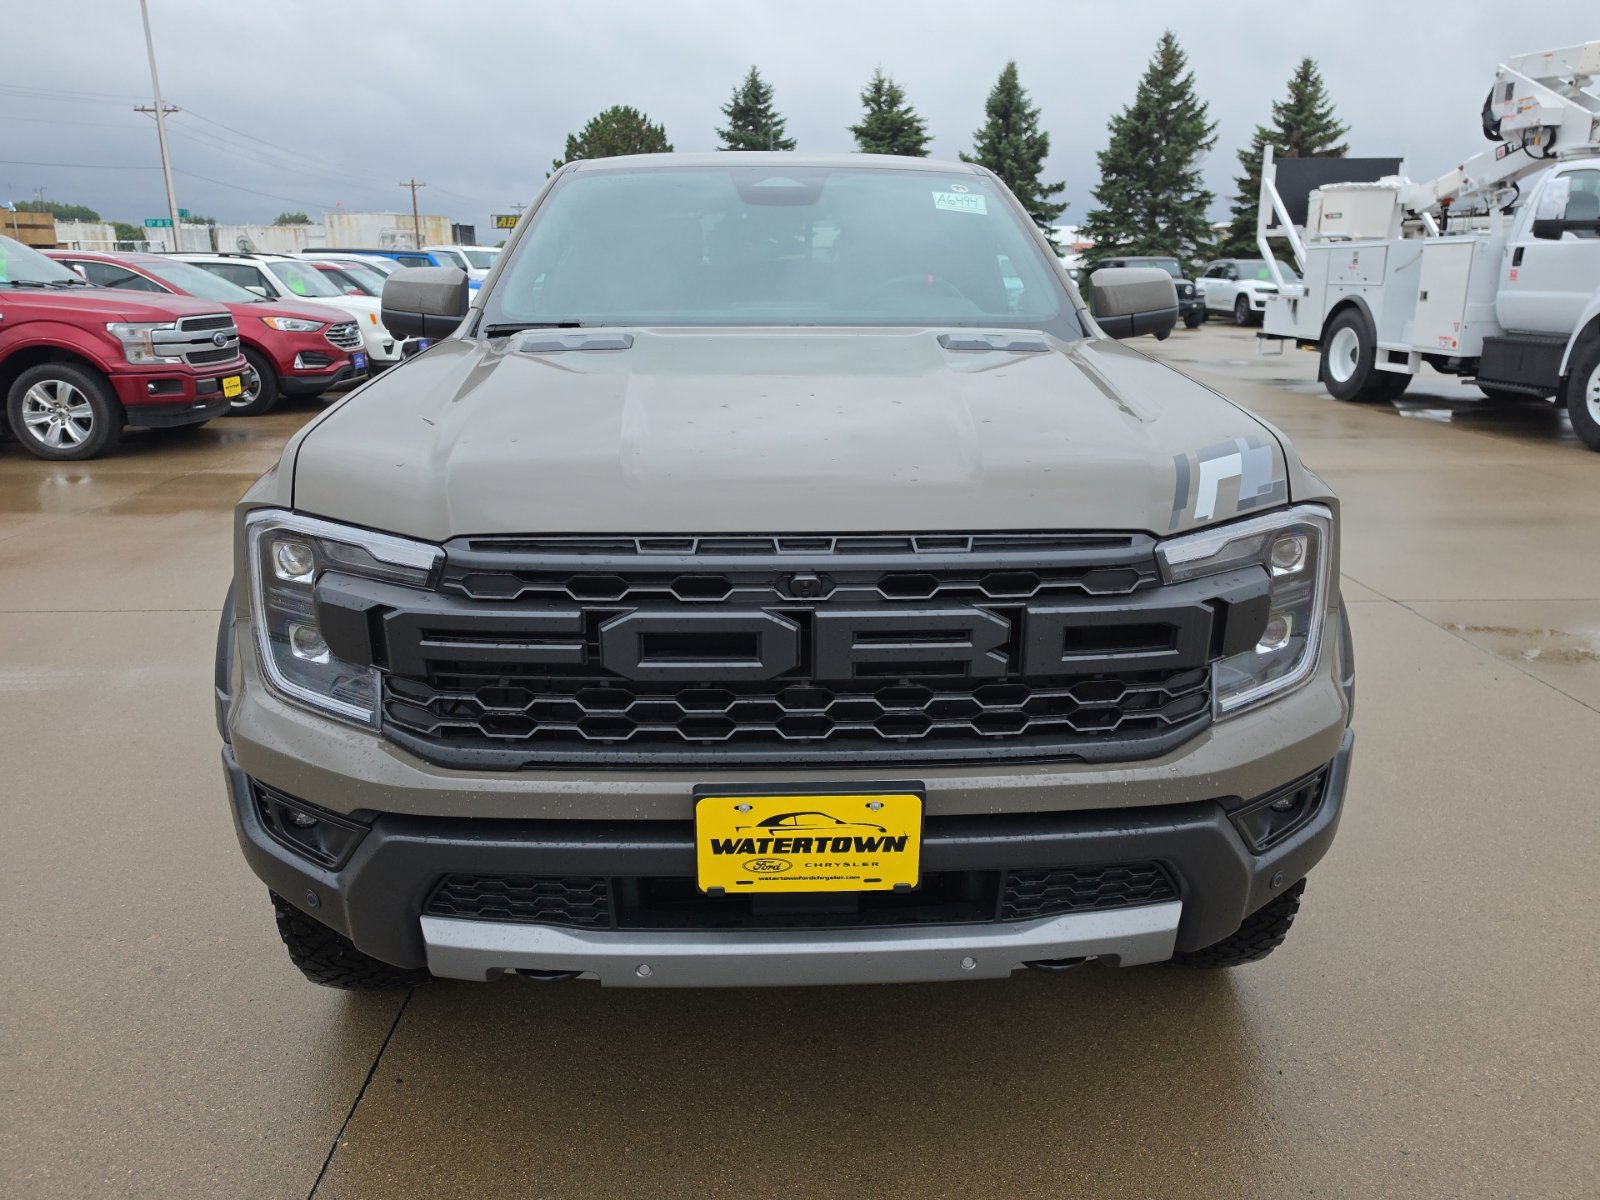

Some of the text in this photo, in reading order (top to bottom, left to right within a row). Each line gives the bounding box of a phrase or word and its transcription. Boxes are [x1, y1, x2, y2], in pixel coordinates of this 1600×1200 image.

[384, 606, 1214, 682] FORD
[710, 836, 907, 855] WATERTOWN
[753, 861, 781, 871] Ford
